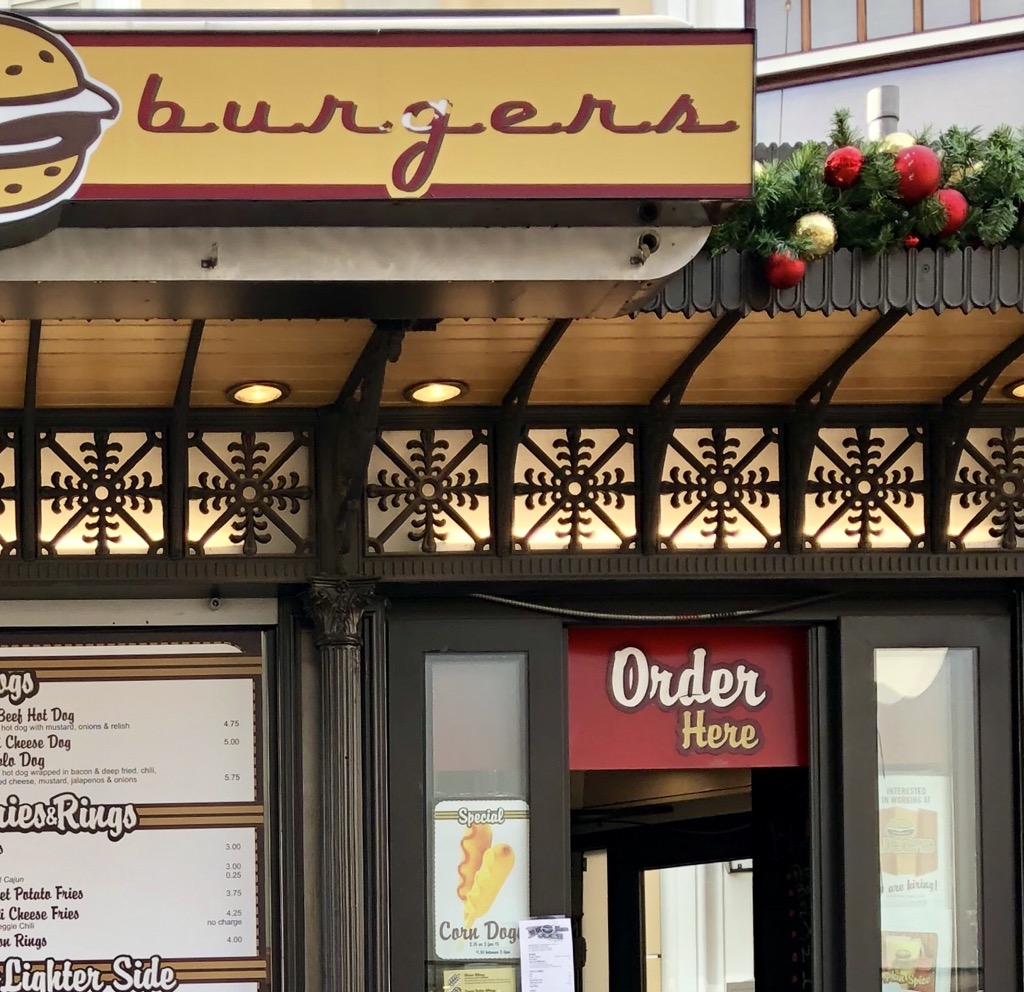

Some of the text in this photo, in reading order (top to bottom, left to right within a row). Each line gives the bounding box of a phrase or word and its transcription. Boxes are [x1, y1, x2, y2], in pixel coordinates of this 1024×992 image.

[136, 74, 741, 193] burgers
[611, 647, 766, 707] Order
[27, 708, 48, 722] Hot
[51, 707, 74, 724] Dog
[682, 710, 759, 749] Here
[5, 735, 45, 749] Cheese
[48, 734, 71, 751] Dog
[224, 738, 240, 746] 5.00
[20, 752, 45, 770] Dog
[886, 787, 927, 795] INTERESTED
[881, 796, 931, 804] IN WORKING AT
[458, 808, 505, 827] Special
[14, 887, 52, 900] Potato
[55, 886, 84, 900] Fries
[888, 879, 938, 893] are hiring!
[9, 907, 47, 921] Cheese
[51, 906, 79, 921] Fries
[218, 918, 242, 927] charge
[439, 921, 479, 940] Corn
[14, 933, 47, 950] Rings
[112, 956, 176, 991] Side
[908, 975, 930, 986] Spice
